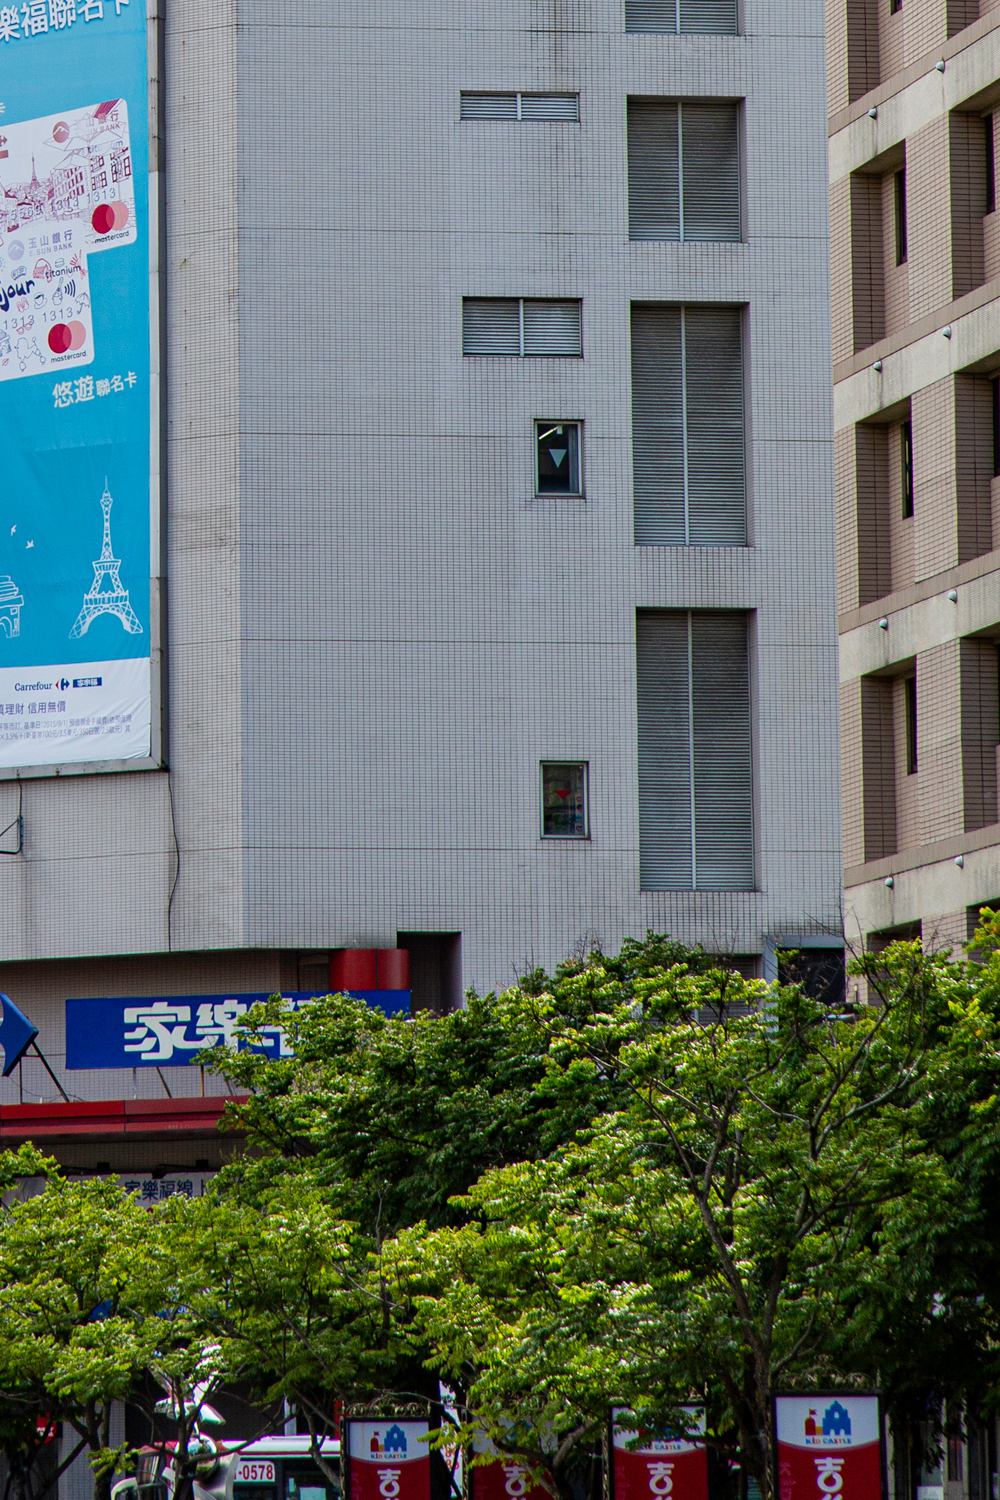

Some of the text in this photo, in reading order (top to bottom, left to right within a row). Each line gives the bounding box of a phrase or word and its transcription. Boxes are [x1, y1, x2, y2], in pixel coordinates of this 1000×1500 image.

[86, 187, 117, 204] 1313
[28, 229, 73, 249] 玉山銀行
[94, 230, 130, 244] mastercard
[53, 241, 73, 253] BANK
[45, 265, 82, 279] titanium
[3, 314, 35, 330] 1313
[42, 307, 73, 322] 1313
[50, 350, 87, 364] mastercard
[52, 370, 137, 408] 悠遊聯名卡
[14, 681, 53, 692] Carrefour
[28, 700, 66, 714] 信用無價
[124, 1000, 316, 1060] 家樂
[233, 1464, 274, 1481] -0578
[646, 1461, 675, 1500] 吉
[814, 1456, 845, 1500] 吉
[377, 1468, 401, 1500] 吉
[503, 1465, 526, 1500] 吉
